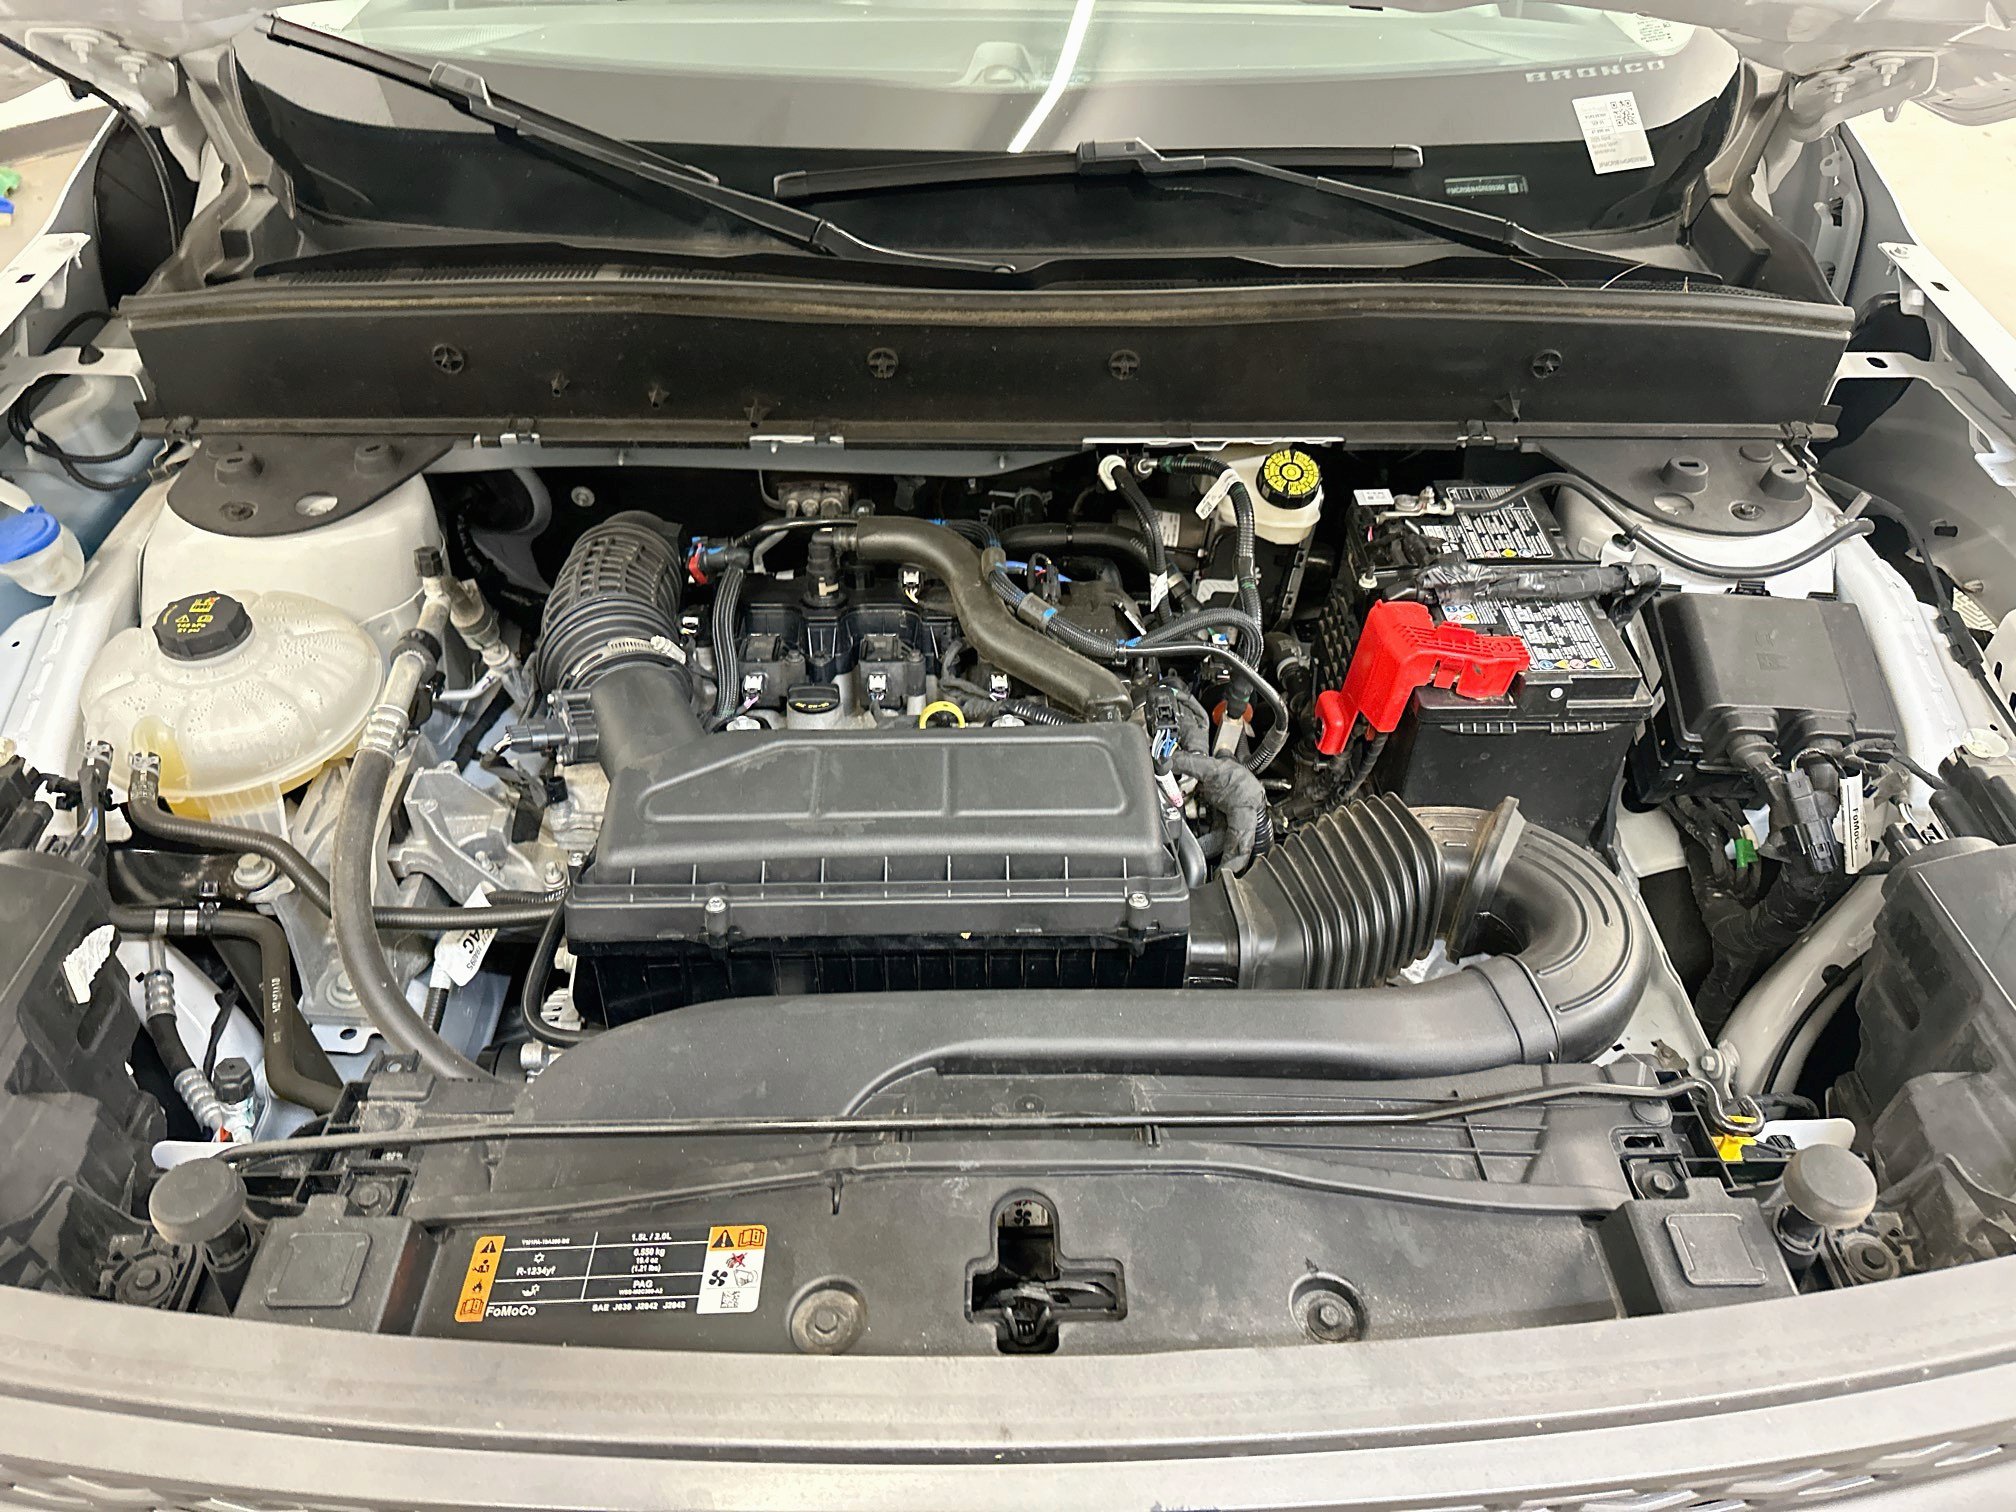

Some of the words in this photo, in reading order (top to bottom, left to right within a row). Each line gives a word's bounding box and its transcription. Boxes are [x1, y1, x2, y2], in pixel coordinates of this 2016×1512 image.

[1525, 60, 1665, 83] BRONCO
[655, 1232, 672, 1241] 2.0L
[656, 1247, 666, 1257] kg
[516, 1265, 556, 1276] R-1234yf
[633, 1279, 653, 1288] PAG
[485, 1304, 536, 1317] FoMoCo
[592, 1303, 610, 1312] SAE
